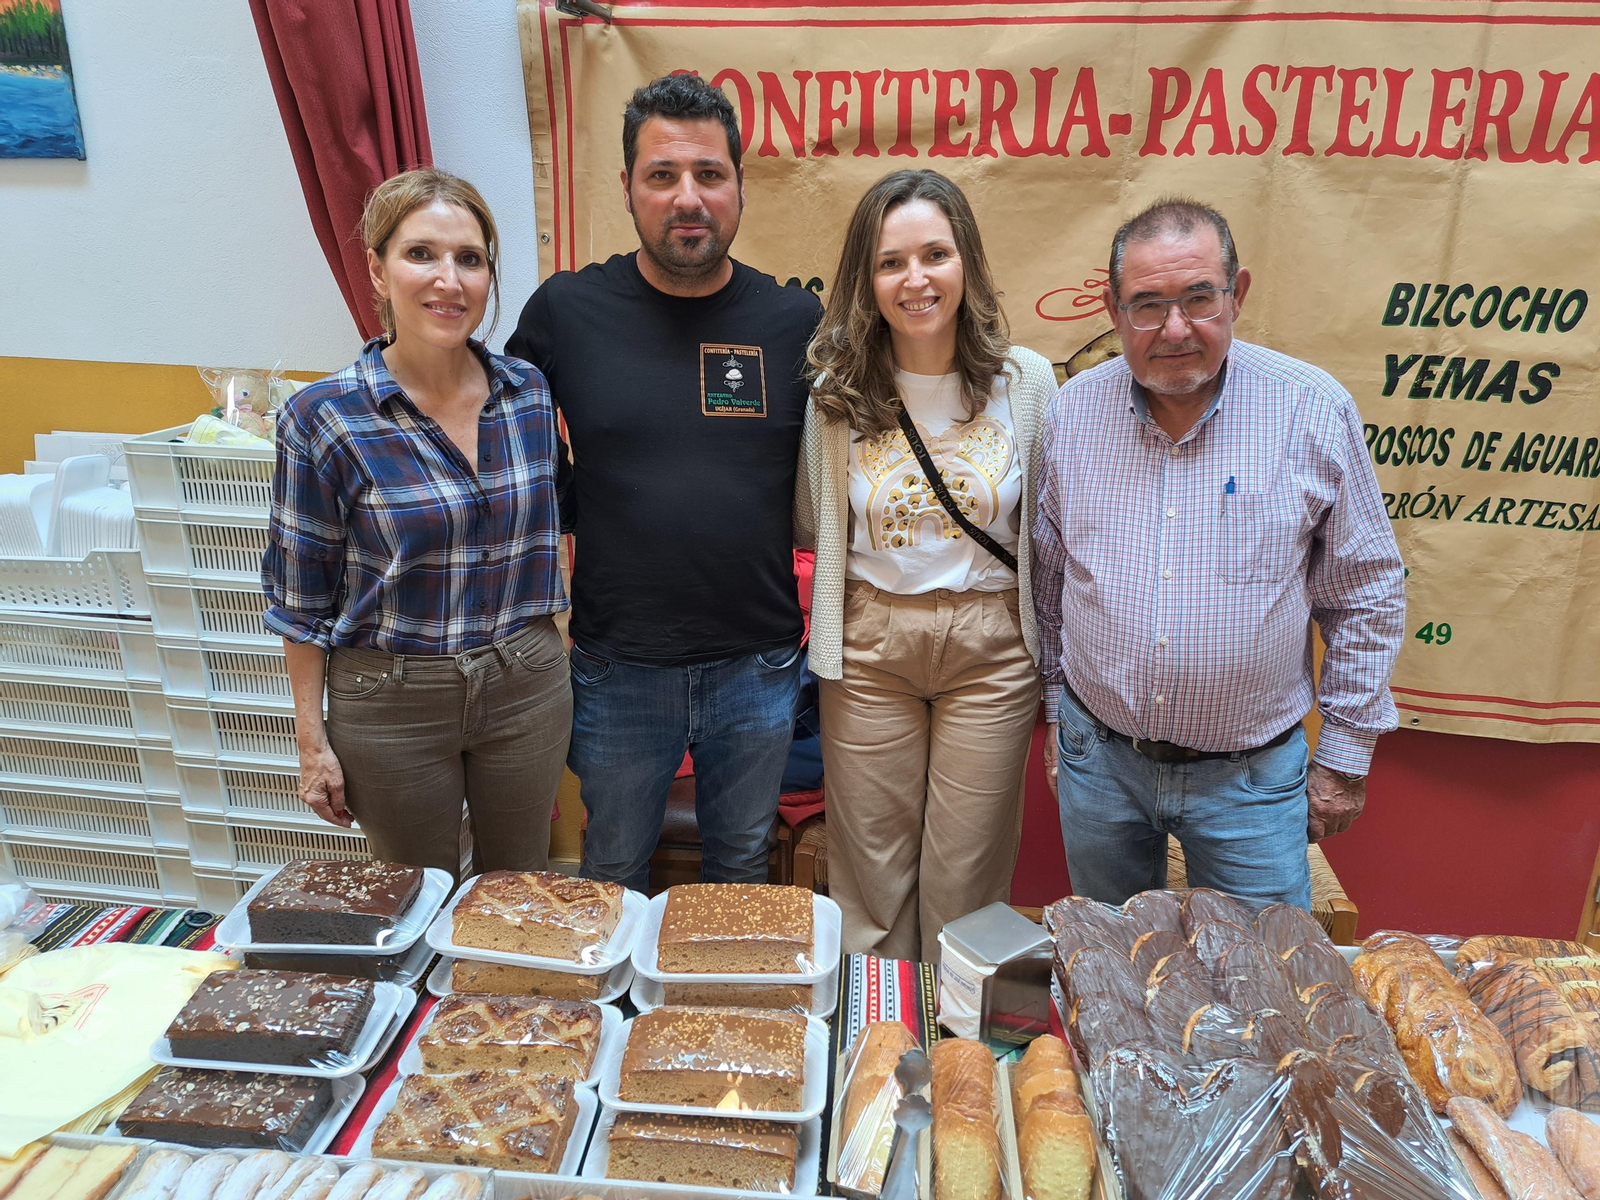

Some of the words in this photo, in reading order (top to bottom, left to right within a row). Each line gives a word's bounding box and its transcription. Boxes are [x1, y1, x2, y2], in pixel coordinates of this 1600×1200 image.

[670, 65, 1600, 164] ONFITERIA-PASTELERIA
[1382, 282, 1589, 334] BIZCOCHO
[1381, 354, 1561, 405] YEMAS
[731, 399, 761, 407] Valverde
[906, 428, 927, 460] TOUS
[1461, 431, 1503, 472] DE
[934, 483, 955, 515] TOUS
[1463, 496, 1600, 532] ARTESA
[969, 527, 991, 547] TOUS
[1415, 621, 1452, 646] 49
